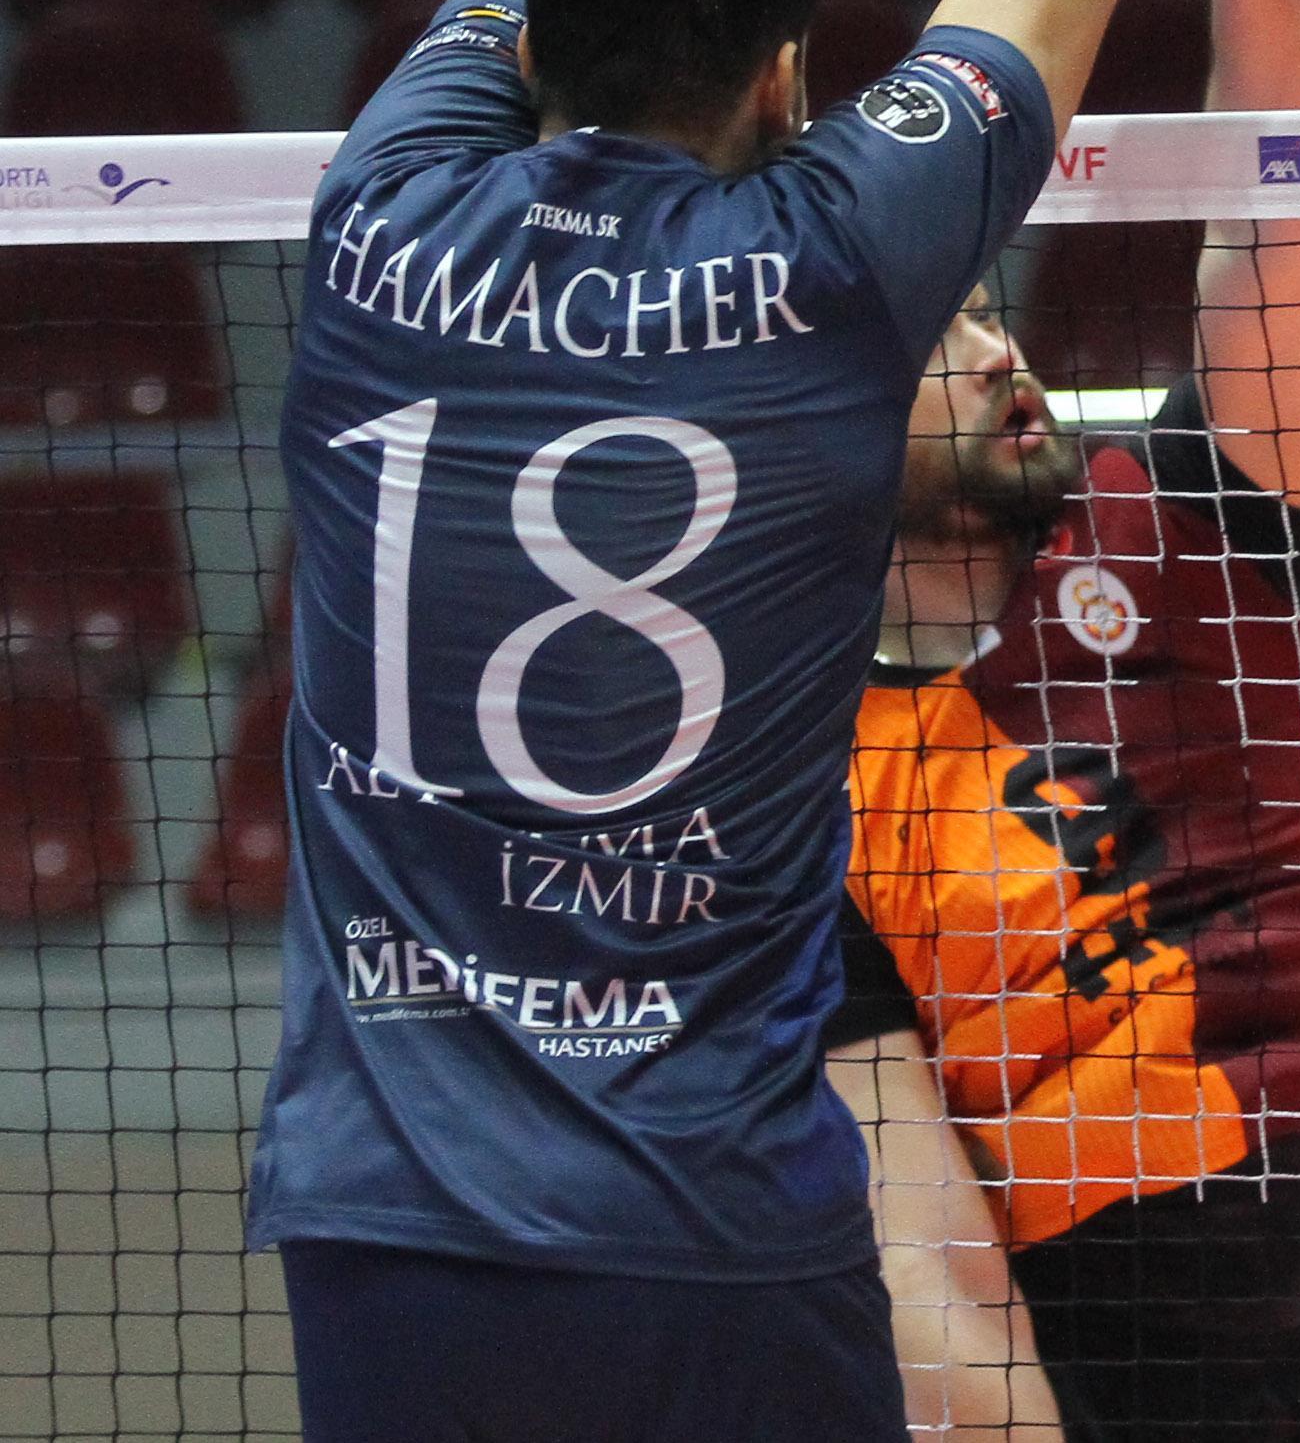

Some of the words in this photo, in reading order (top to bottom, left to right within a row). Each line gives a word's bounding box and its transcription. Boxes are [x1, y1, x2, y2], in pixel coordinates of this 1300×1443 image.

[1056, 146, 1107, 181] VF
[1261, 159, 1300, 180] AXA
[520, 202, 594, 237] LTEKMA
[596, 213, 622, 239] SK
[326, 201, 815, 358] HAMACHER
[326, 397, 738, 815] 18
[500, 840, 723, 925] İZMİR
[345, 915, 394, 940] ÖZEL
